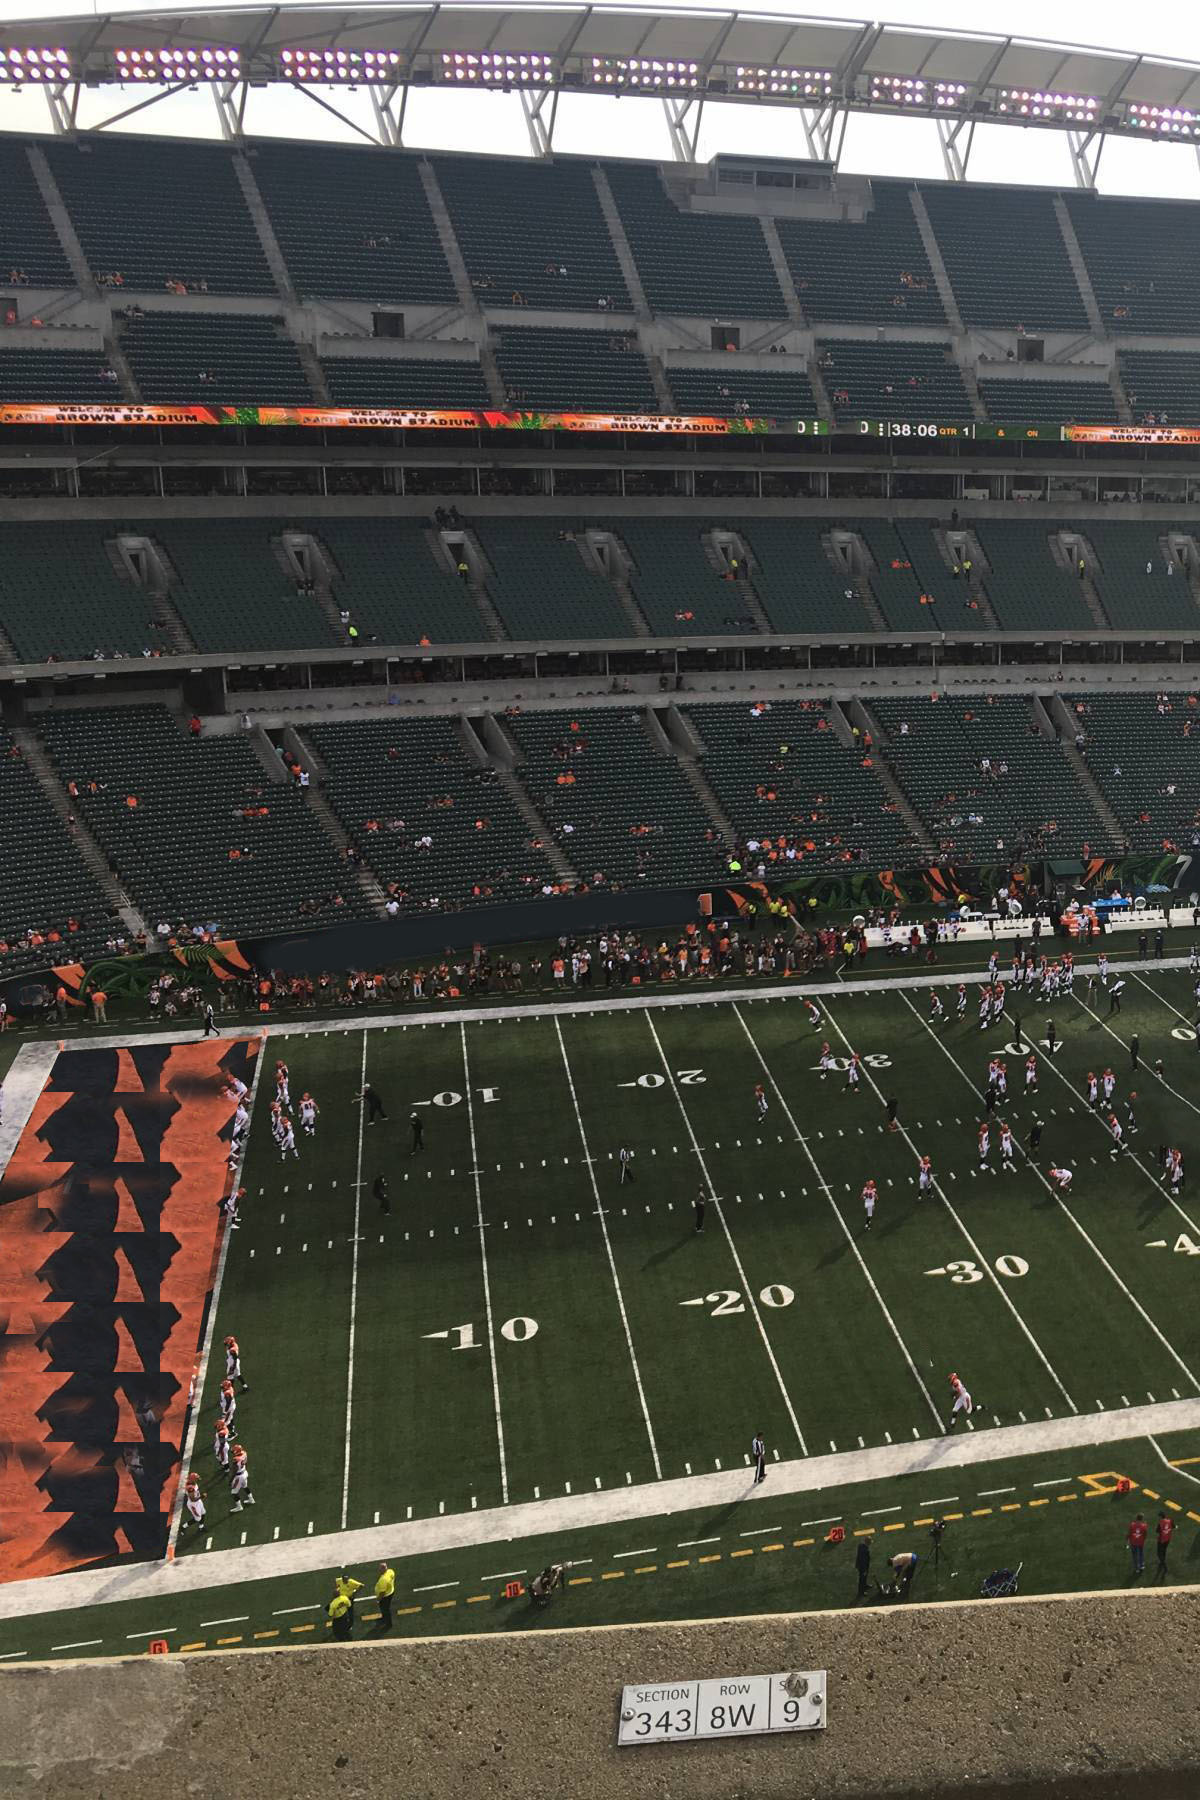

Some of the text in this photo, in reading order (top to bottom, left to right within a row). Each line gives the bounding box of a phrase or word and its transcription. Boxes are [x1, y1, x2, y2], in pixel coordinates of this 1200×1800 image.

[56, 413, 116, 422] BROWN
[122, 414, 198, 423] STADIUM
[348, 417, 402, 425] BROWN
[408, 418, 476, 426] STADIUM
[665, 423, 726, 432] STADIUM
[892, 424, 969, 437] 38:06 QTR 1
[1026, 430, 1039, 438] ON
[946, 1254, 1030, 1285] 30
[705, 1284, 795, 1317] 20
[451, 1316, 539, 1351] 10
[636, 1687, 691, 1704] SECTION
[720, 1683, 751, 1696] ROW
[635, 1699, 800, 1736] 343 8W 9
